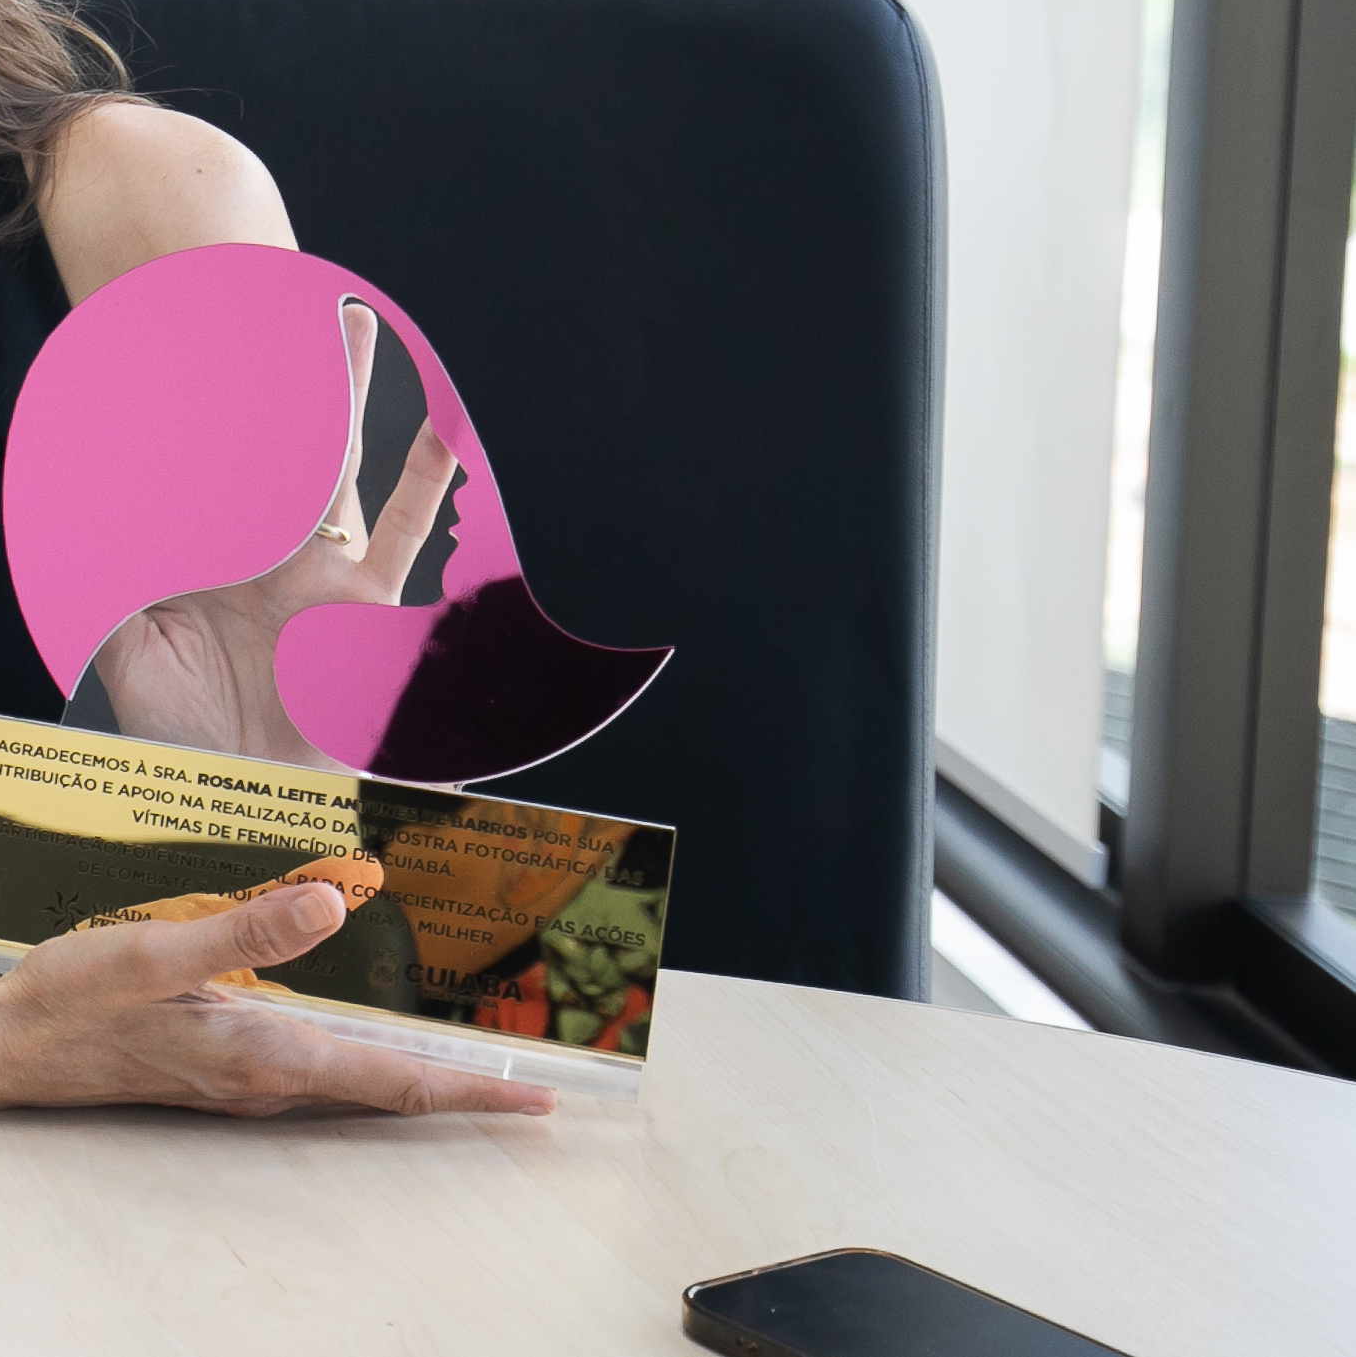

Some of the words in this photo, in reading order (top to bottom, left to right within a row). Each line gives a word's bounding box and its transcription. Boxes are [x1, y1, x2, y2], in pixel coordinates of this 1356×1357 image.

[102, 780, 113, 794] E
[117, 784, 175, 805] APOIO
[179, 794, 205, 811] NA
[211, 800, 327, 832] REALIZAÇÃO
[331, 820, 358, 837] DA
[382, 829, 458, 854] MOSTRA
[464, 841, 597, 877] FOTOGRÁFICA
[603, 865, 644, 886] DAS
[132, 808, 203, 834] VÍTIMAS
[207, 822, 233, 840] DE
[237, 827, 347, 858] FEMINICÍDIO
[352, 847, 378, 864] DE
[382, 851, 457, 878] CUIABÁ.
[135, 759, 148, 776] À
[153, 765, 193, 783] SRA.
[197, 773, 272, 798] ROSANA
[277, 786, 327, 806] LEITE
[330, 795, 418, 821] ANTUNES
[422, 809, 447, 826] DE
[451, 816, 527, 840] BARROS
[533, 829, 572, 847] POR
[576, 837, 615, 855] SUA
[77, 859, 101, 876] DE
[106, 865, 191, 890] COMBATE
[121, 844, 153, 861] FOI
[156, 849, 292, 886] FUNDAMENTAL
[350, 883, 530, 927] CONSCIENTIZAÇÃO
[534, 915, 547, 930] E
[550, 918, 575, 936] AS
[579, 923, 646, 948] AÇÕES
[417, 919, 498, 946] MULHER.
